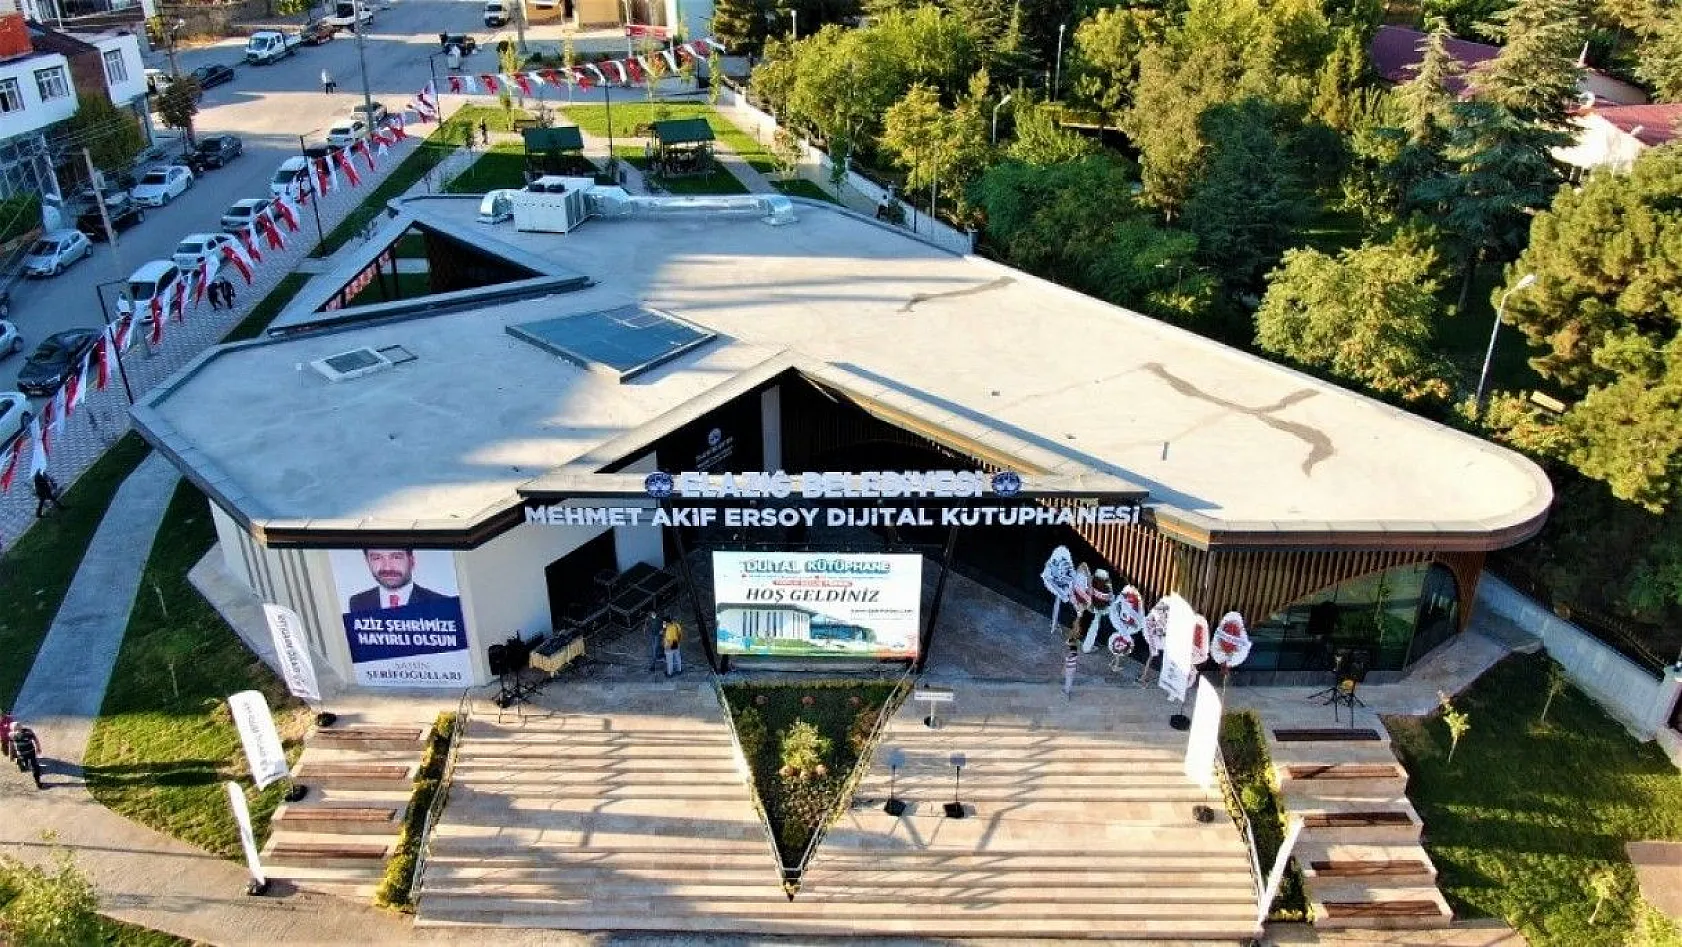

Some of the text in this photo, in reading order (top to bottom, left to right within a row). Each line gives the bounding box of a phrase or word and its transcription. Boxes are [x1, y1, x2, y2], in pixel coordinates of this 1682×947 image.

[525, 505, 1140, 527] MEHMET AKİF ERSOY DİJİTAL KÜTÜPHANESİ
[746, 586, 880, 604] HOŞ GELDİNİZ
[353, 616, 384, 631] AZİZ
[358, 632, 457, 647] HAYIRLI OLSUN
